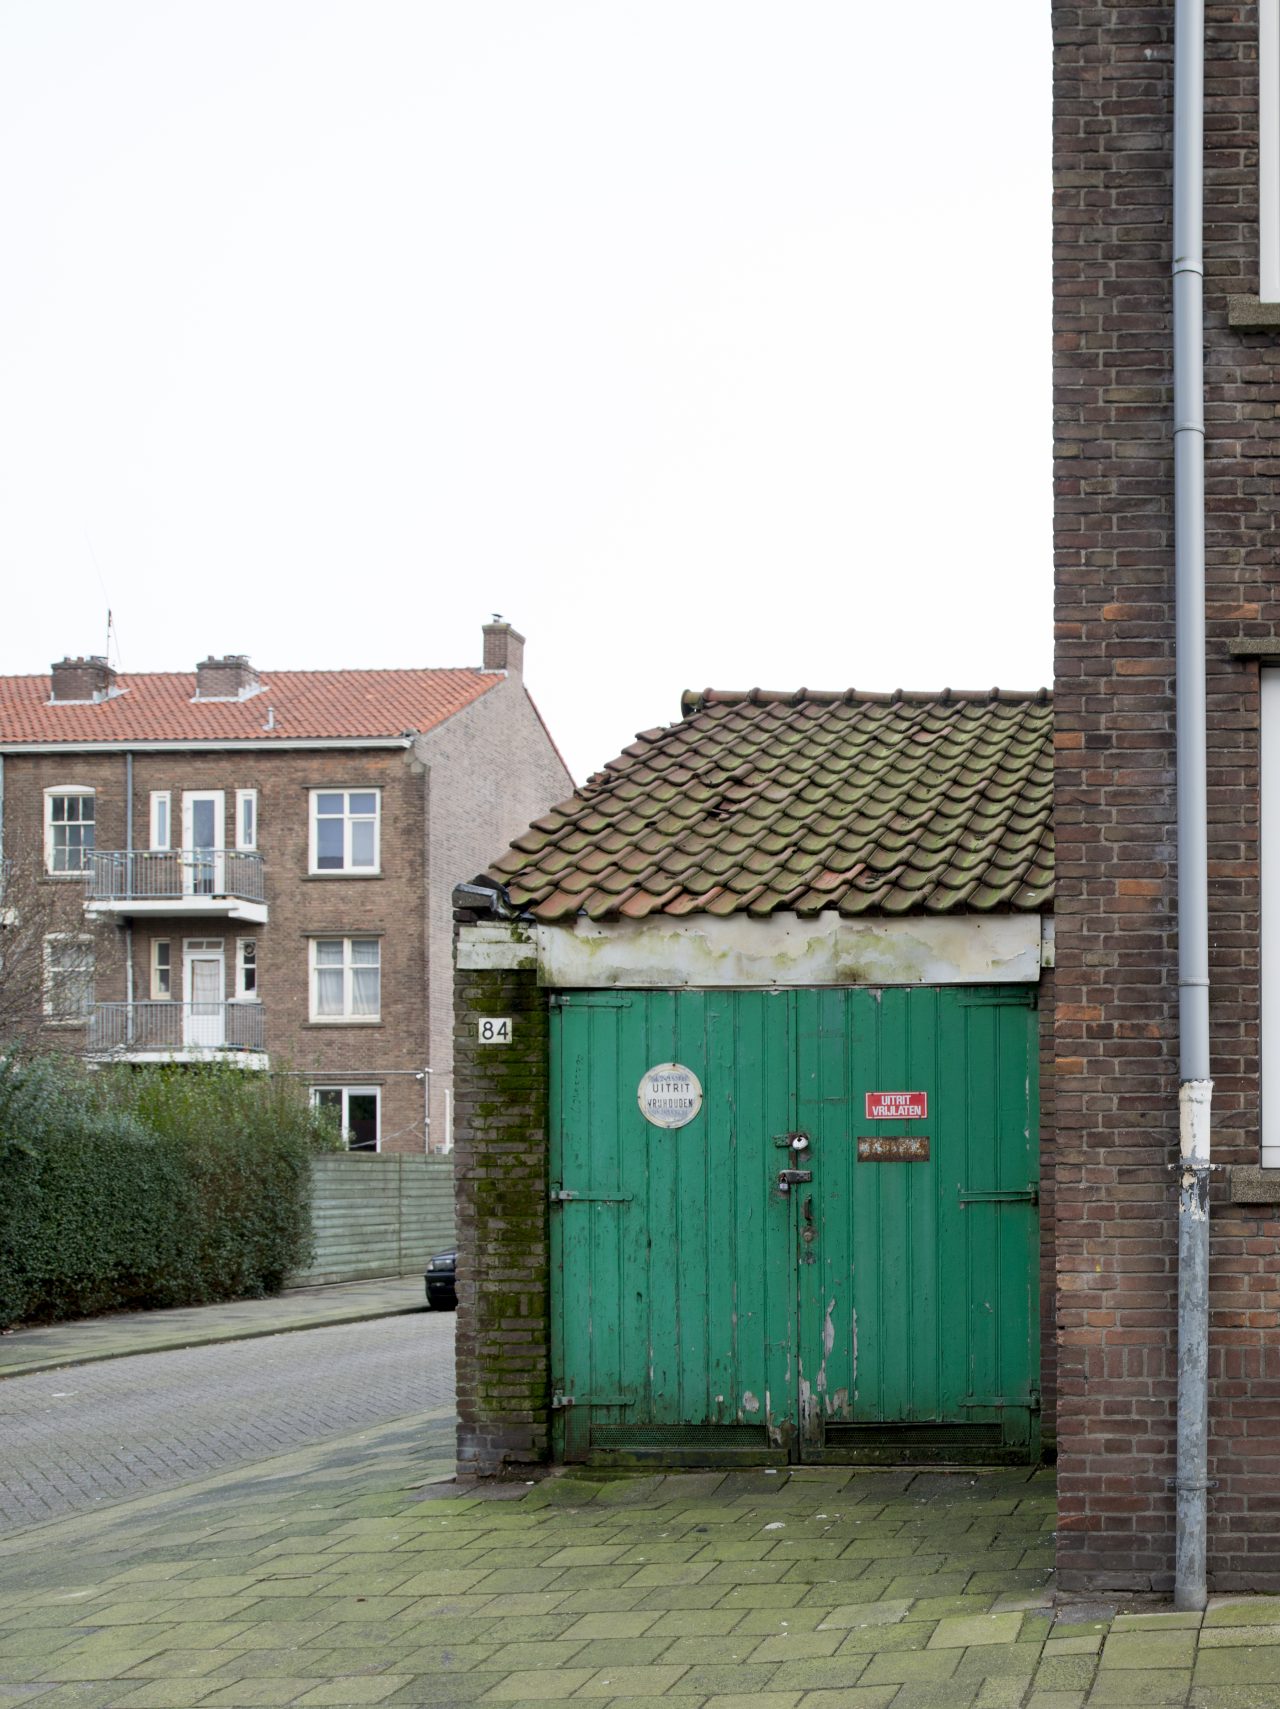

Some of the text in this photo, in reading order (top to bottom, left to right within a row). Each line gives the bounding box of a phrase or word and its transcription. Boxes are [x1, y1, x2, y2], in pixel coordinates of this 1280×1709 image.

[482, 1021, 509, 1040] 84
[652, 1083, 690, 1093] UITRIT
[881, 1095, 911, 1106] UITRIT
[872, 1105, 921, 1116] VRIJLATEN
